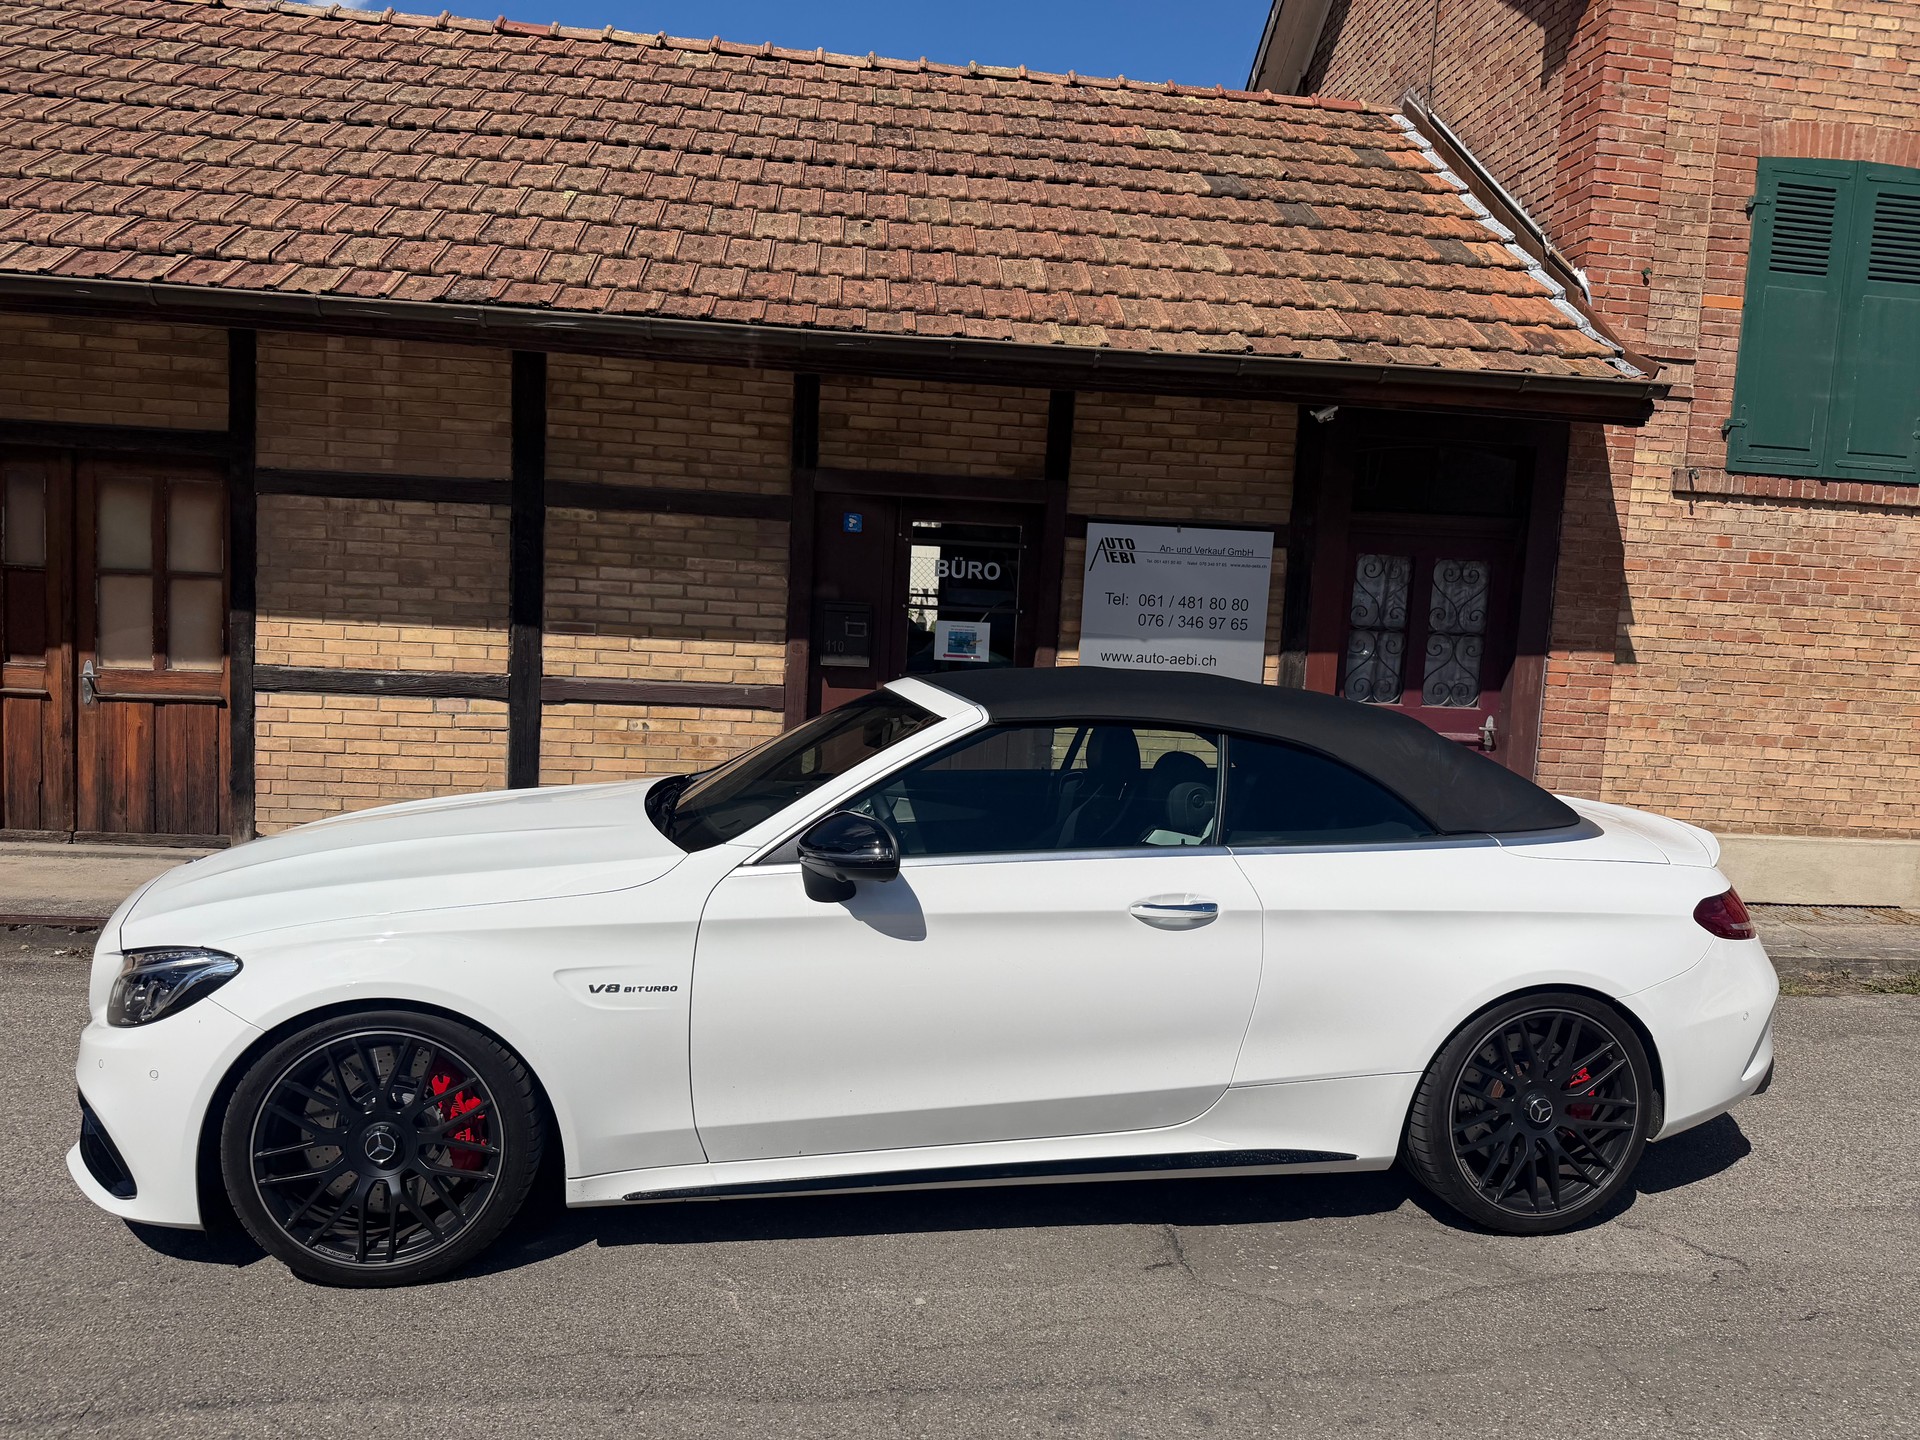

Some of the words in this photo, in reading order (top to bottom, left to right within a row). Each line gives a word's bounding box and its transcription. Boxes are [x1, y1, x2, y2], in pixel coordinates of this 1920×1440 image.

[1160, 545, 1174, 553] An-
[1176, 546, 1192, 554] und
[1194, 546, 1226, 555] Verkauf
[1227, 548, 1254, 557] GmbH
[935, 557, 1001, 581] BÜRO
[1105, 592, 1129, 606] Tel:
[1139, 594, 1163, 607] 061
[1169, 595, 1174, 608] /
[1178, 596, 1203, 609] 481
[1209, 597, 1227, 610] 80
[1231, 598, 1249, 611] 80
[1138, 614, 1164, 627] 076
[1168, 615, 1174, 627] /
[1178, 615, 1204, 629] 346
[1209, 617, 1226, 630] 97
[1231, 618, 1248, 631] 65
[826, 640, 844, 652] 110
[1101, 652, 1217, 667] www.auto-aebi.ch
[589, 984, 620, 993] V8
[624, 985, 678, 993] BITURBO
